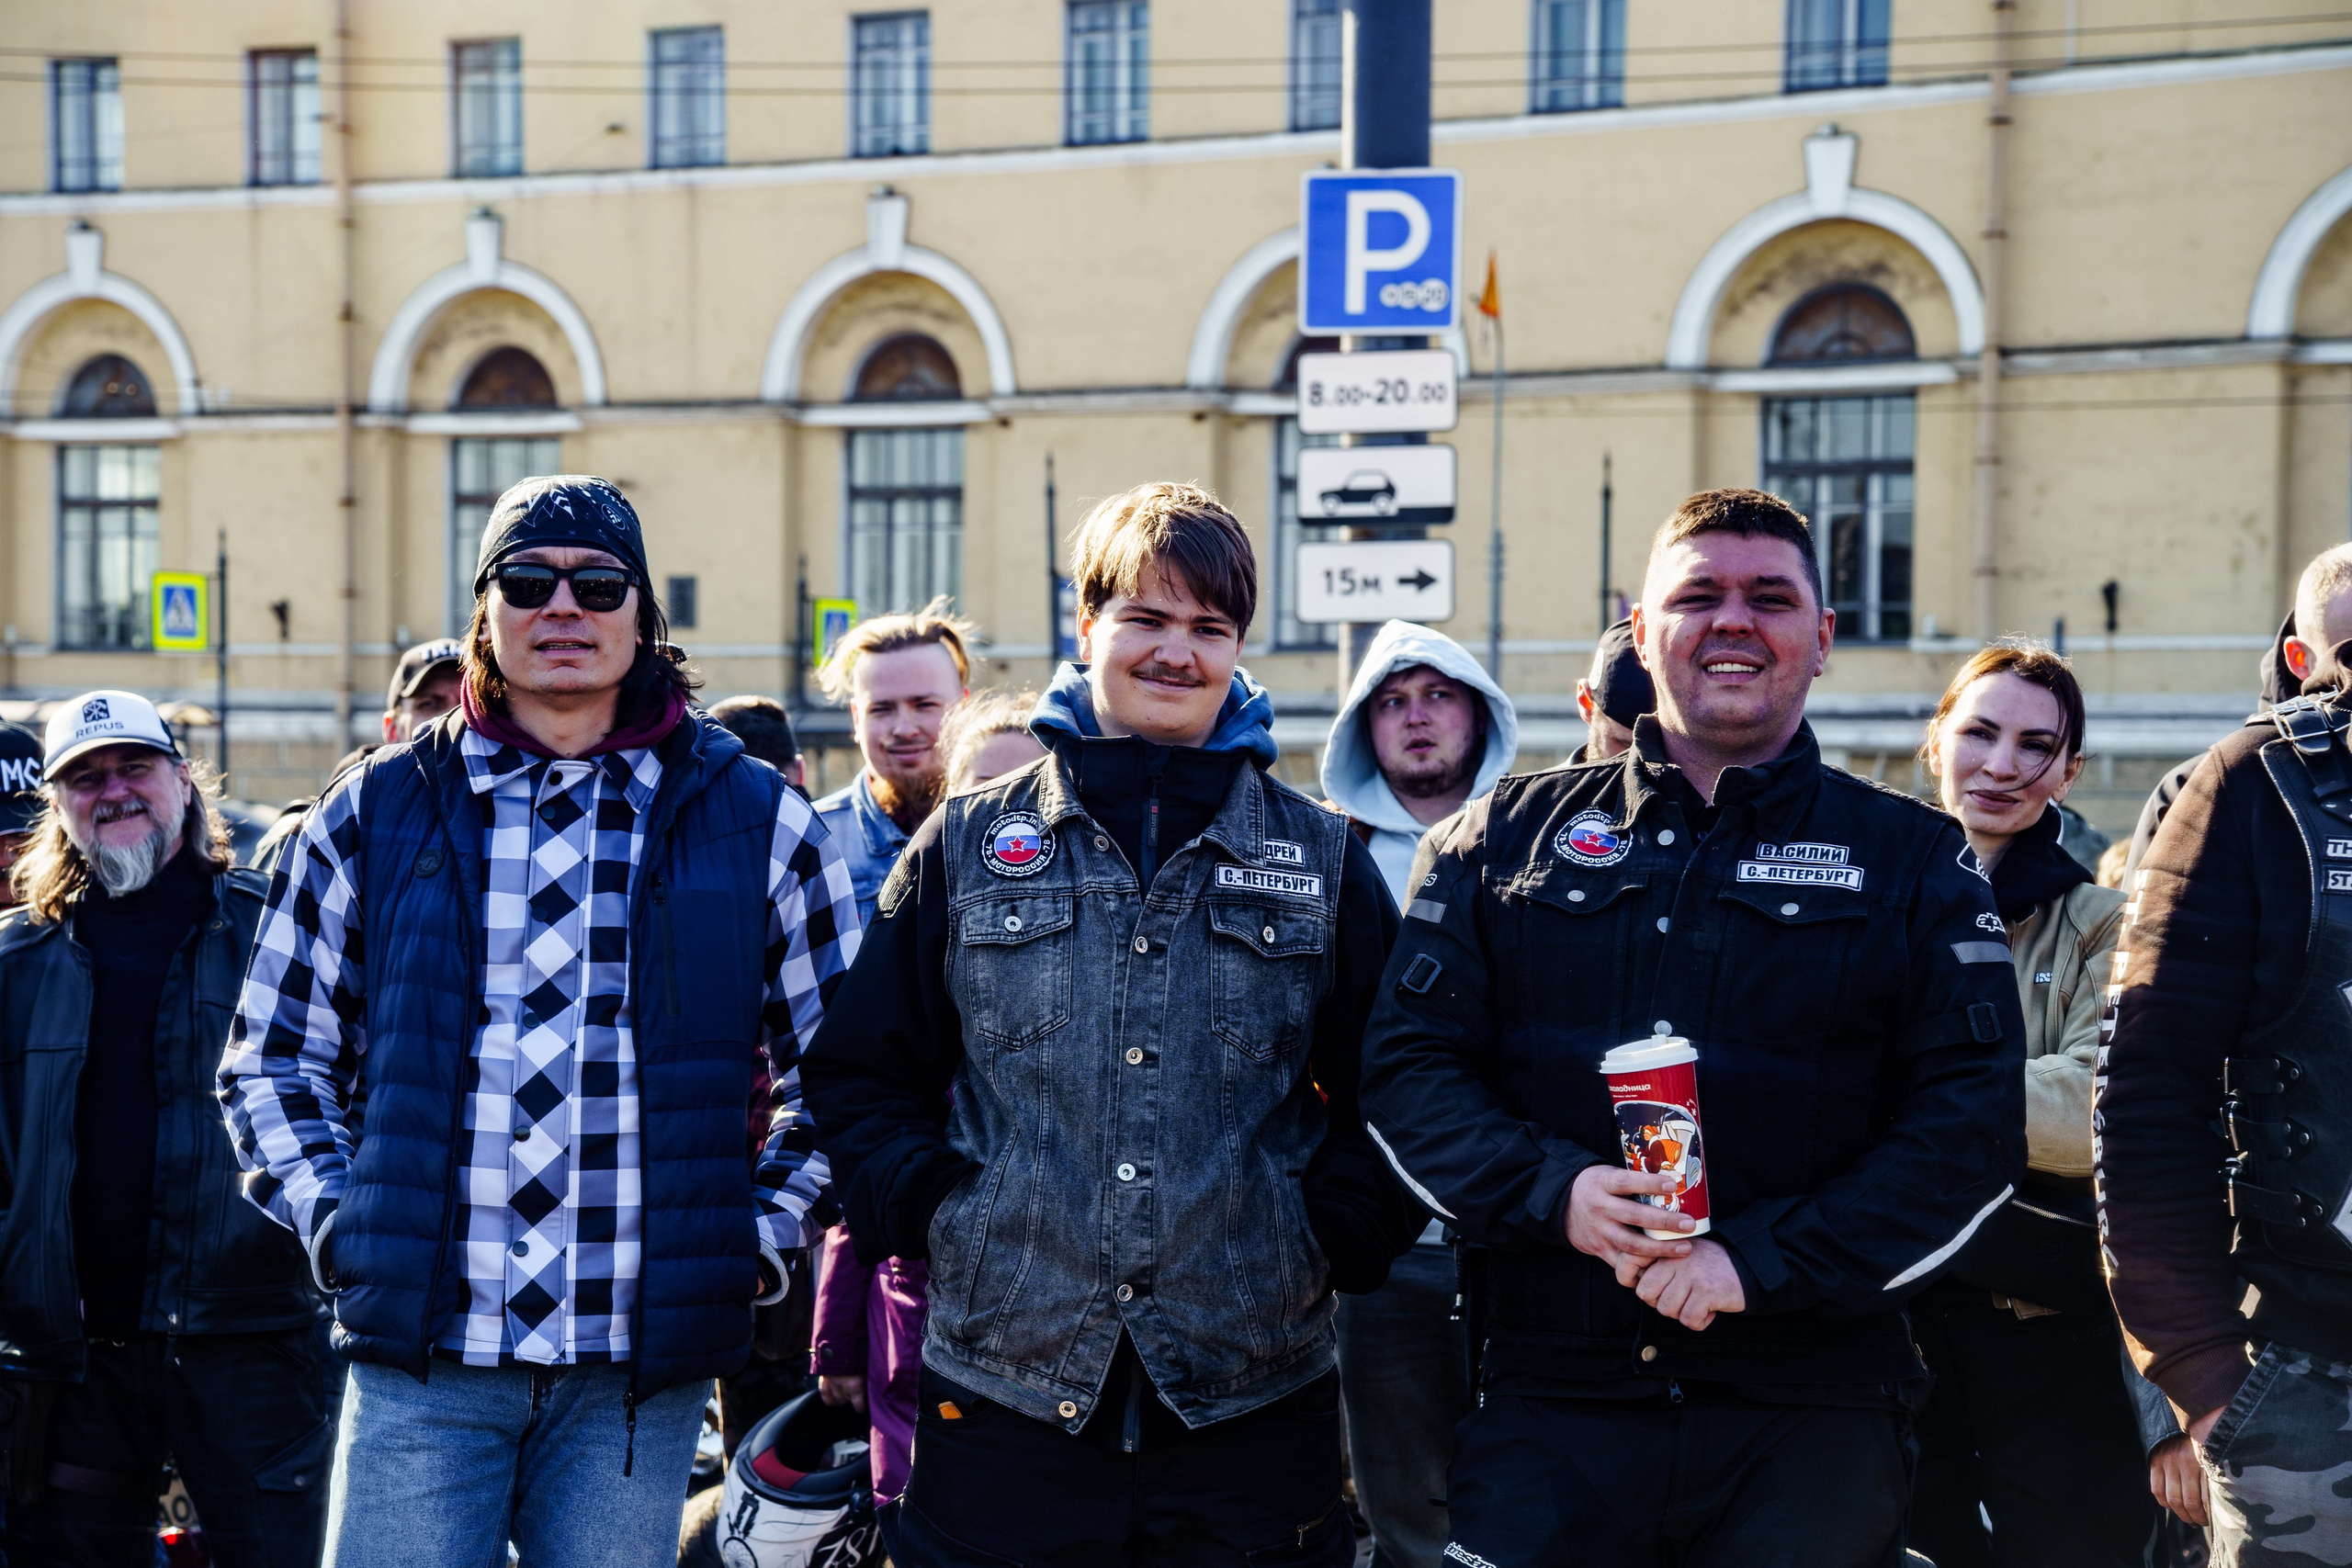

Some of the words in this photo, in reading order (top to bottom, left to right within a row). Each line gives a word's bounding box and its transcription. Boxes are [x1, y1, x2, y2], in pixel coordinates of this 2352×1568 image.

[1344, 189, 1431, 315] P
[1309, 378, 1447, 407] 8.00-20.00
[76, 721, 124, 739] REPUS
[990, 815, 1038, 835] motodtp.in
[1560, 844, 1620, 863] МОТОРОССИЯ
[1763, 845, 1842, 863] ВАСИЛИЙ
[989, 854, 1046, 873] МОТОРОССИЯ
[1225, 870, 1315, 892] С.-ПЕТЕРБУРГ
[1747, 866, 1853, 883] С.-ПЕТЕРБУРГ
